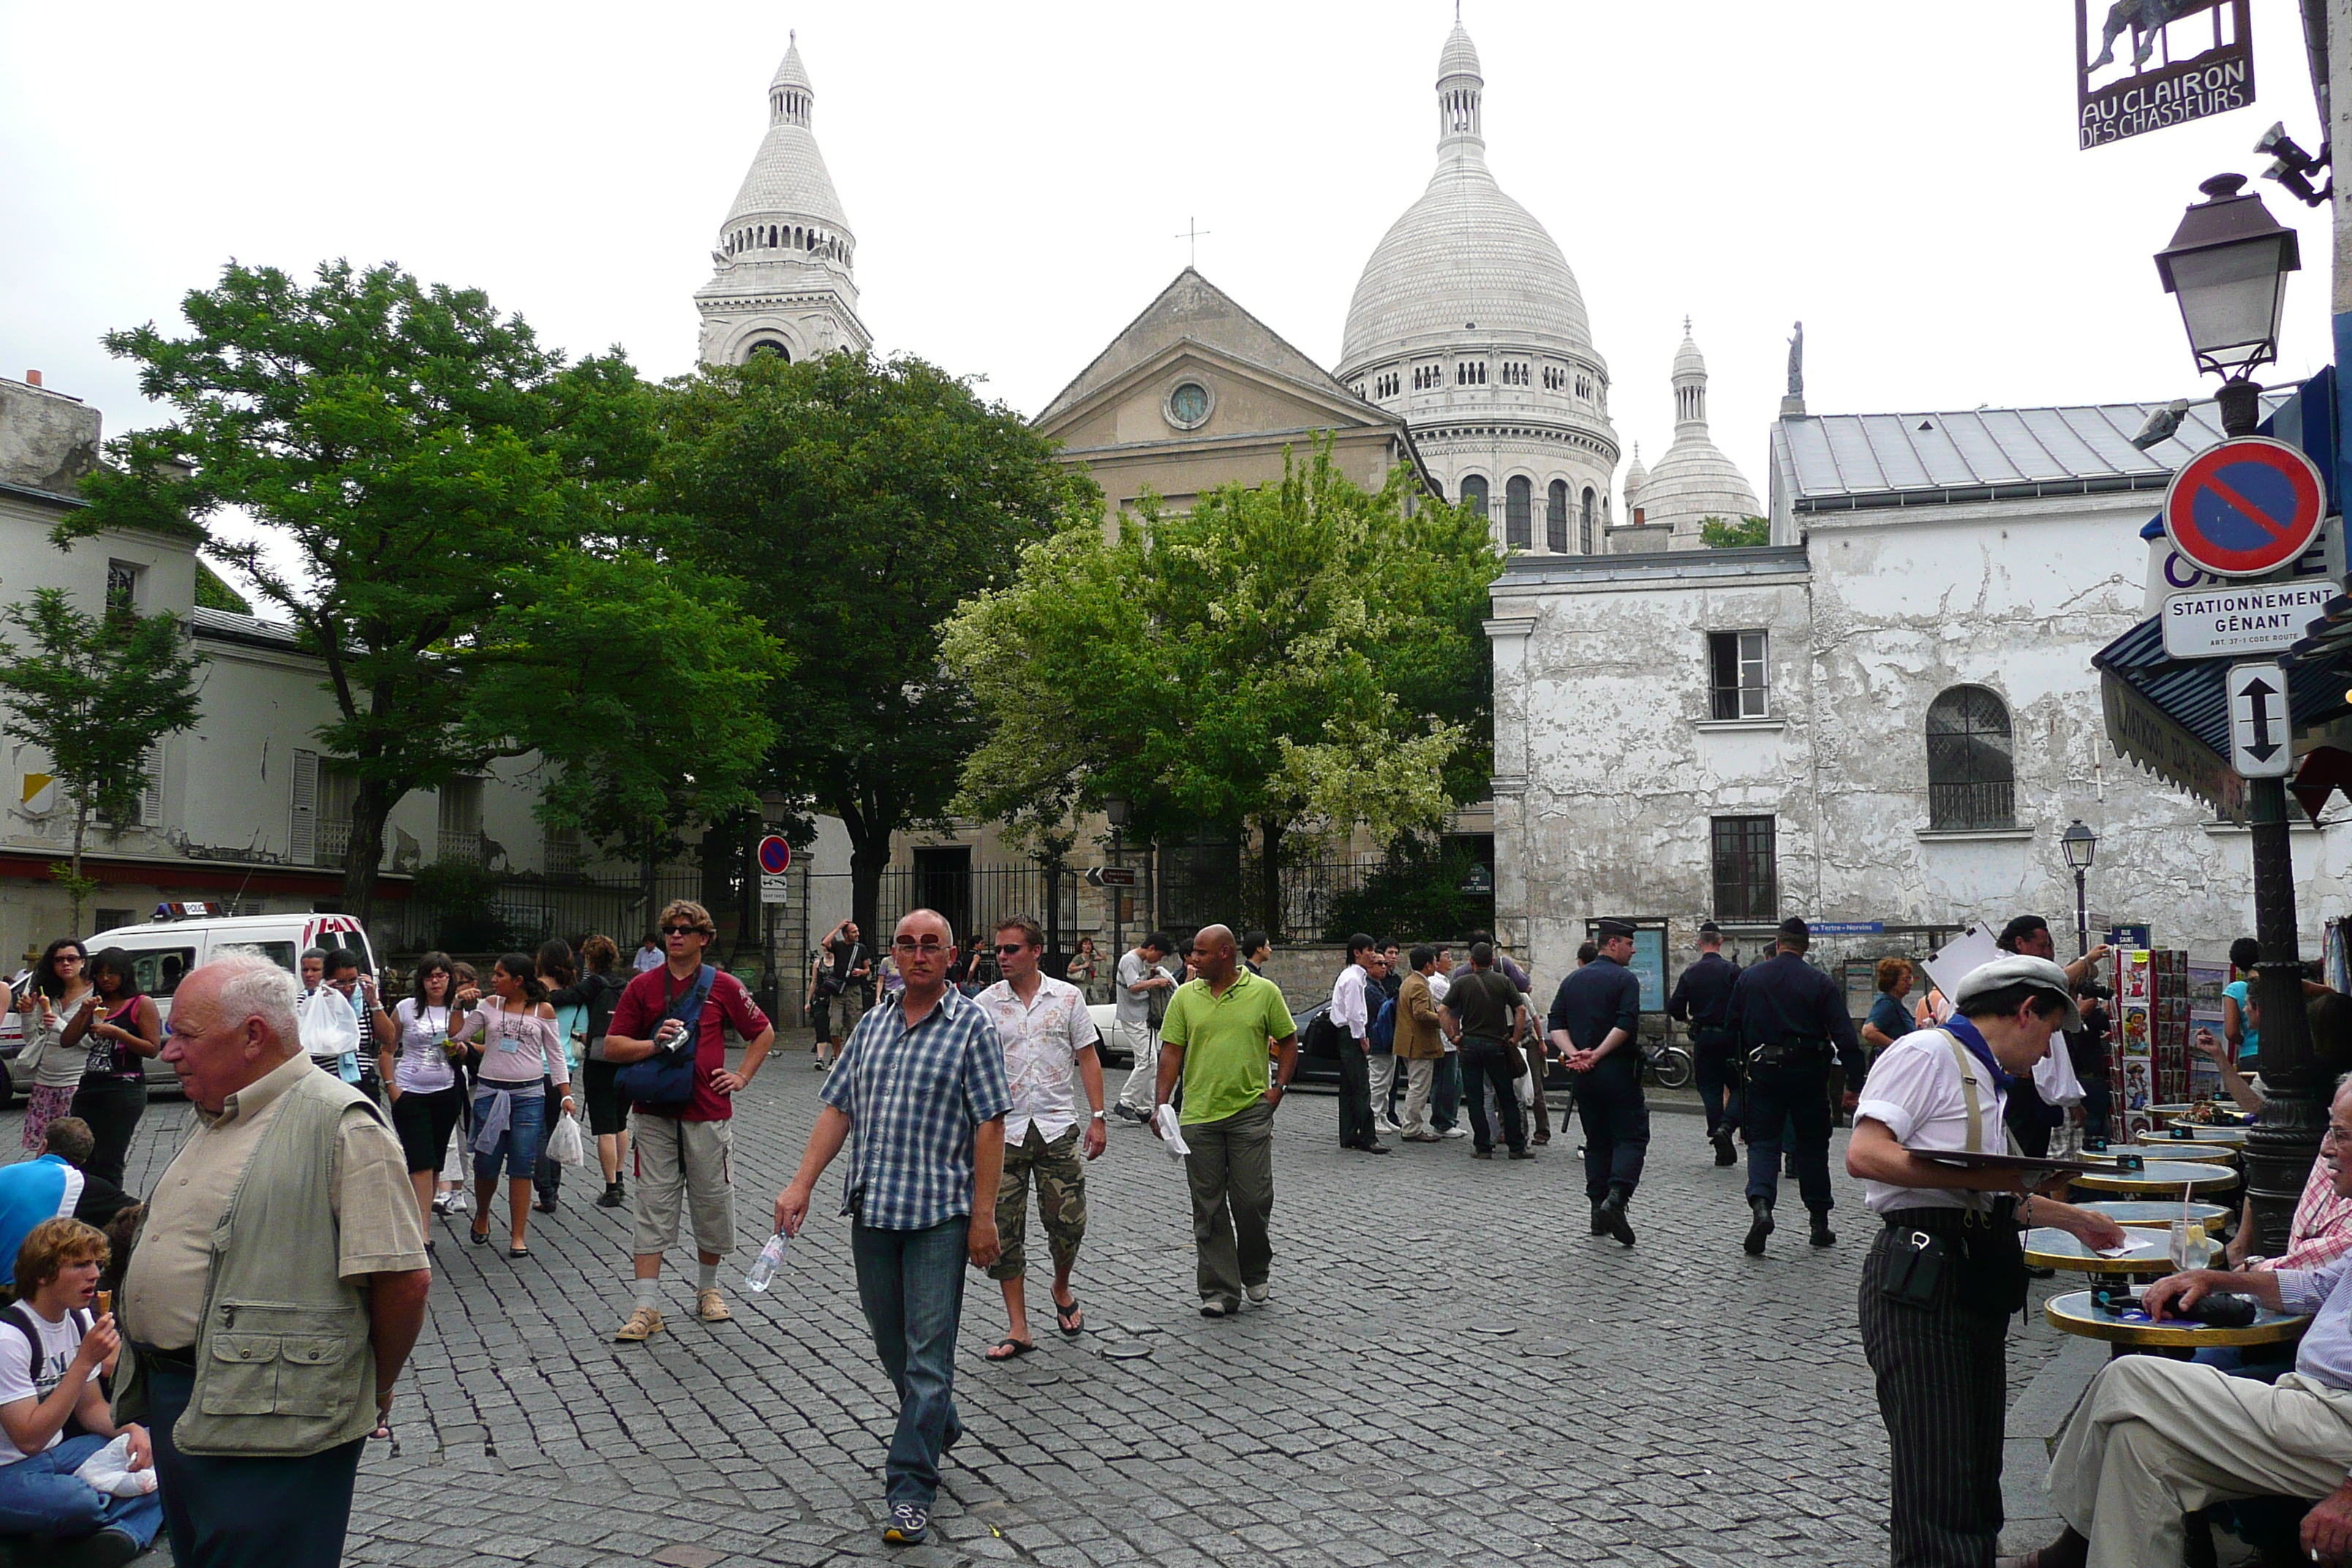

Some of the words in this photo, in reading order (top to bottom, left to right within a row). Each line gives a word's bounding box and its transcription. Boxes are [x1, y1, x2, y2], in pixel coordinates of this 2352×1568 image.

[2081, 96, 2117, 126] AU
[2123, 60, 2244, 113] CLAIRON
[2080, 121, 2117, 149] DES
[2119, 85, 2244, 137] CHASSEURS
[2164, 533, 2327, 588] CE
[2173, 589, 2333, 617] STATIONNEMENT
[2215, 614, 2291, 633] GÊNANT
[2210, 638, 2226, 647] ART.
[2229, 637, 2247, 645] 37-1
[2249, 636, 2270, 644] CODE
[2273, 633, 2299, 641] ROUTE
[186, 904, 206, 912] POLIC
